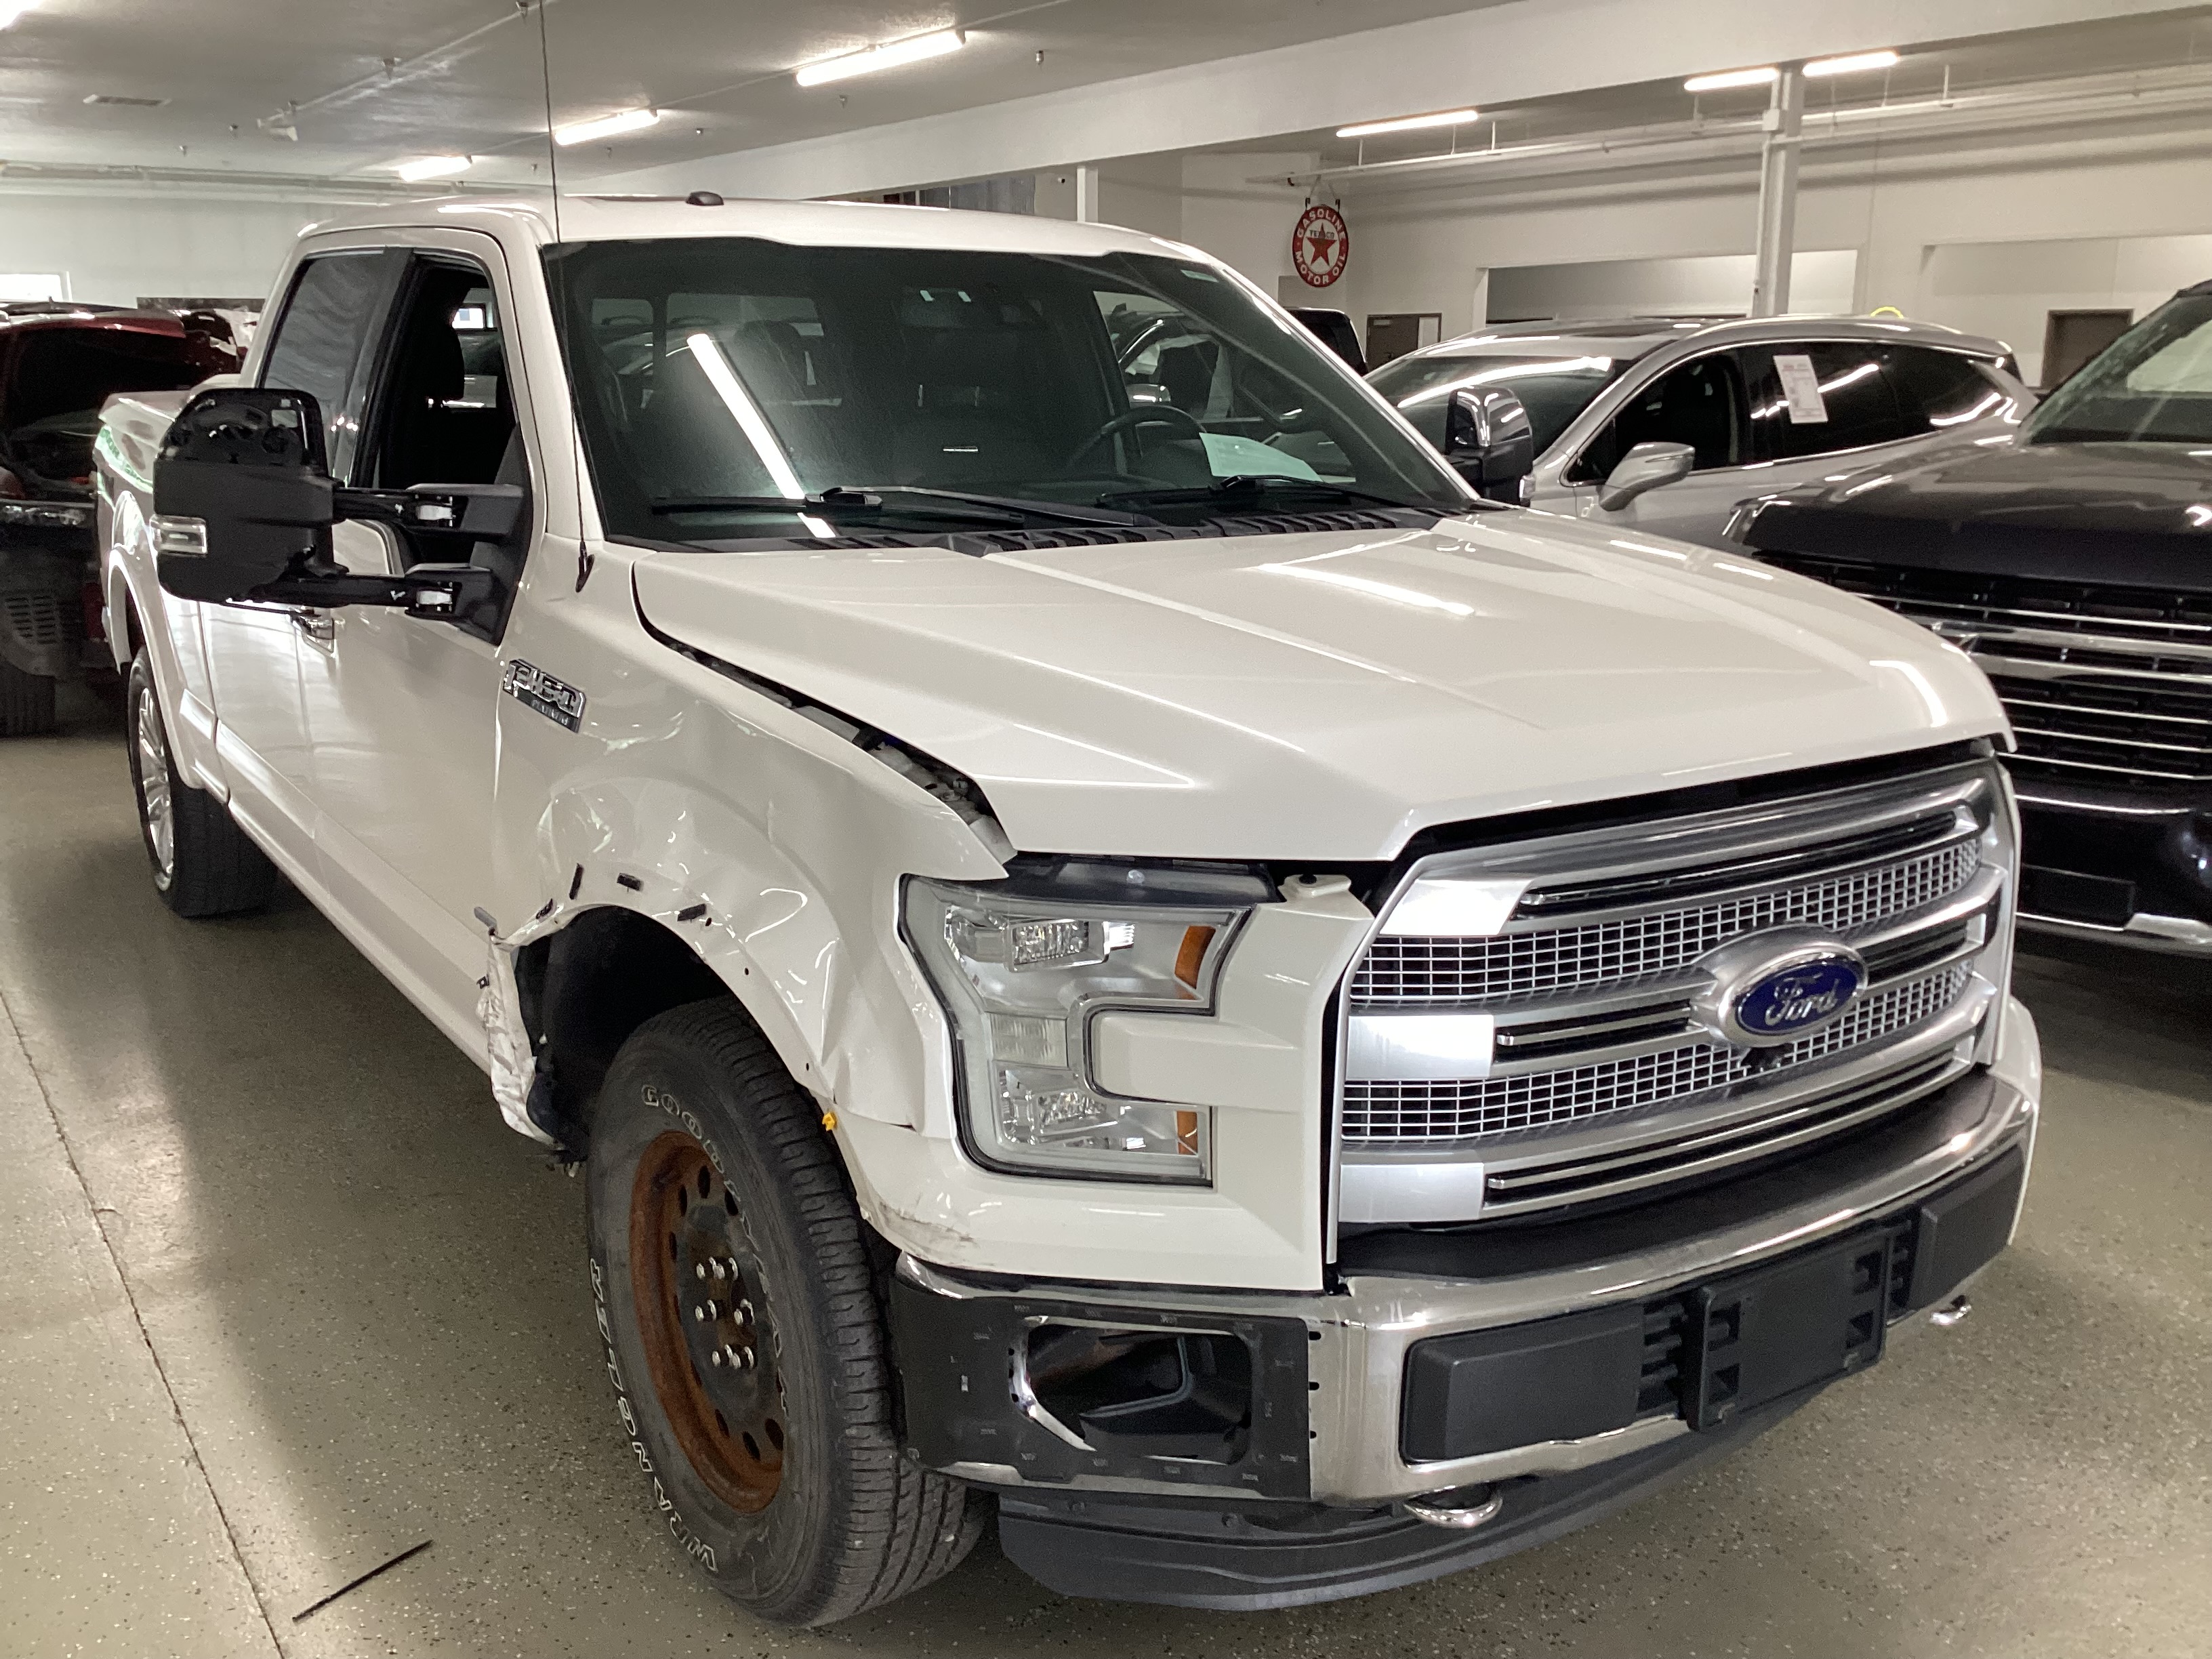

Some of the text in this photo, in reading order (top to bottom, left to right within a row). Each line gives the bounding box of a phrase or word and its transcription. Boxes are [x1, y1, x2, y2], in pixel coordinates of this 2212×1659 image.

[1297, 208, 1346, 241] GASOLINE
[1309, 229, 1334, 239] TECO
[1295, 251, 1346, 285] MOTOR OIL
[1764, 972, 1841, 1026] Ford
[590, 1258, 718, 1573] WRANGLER
